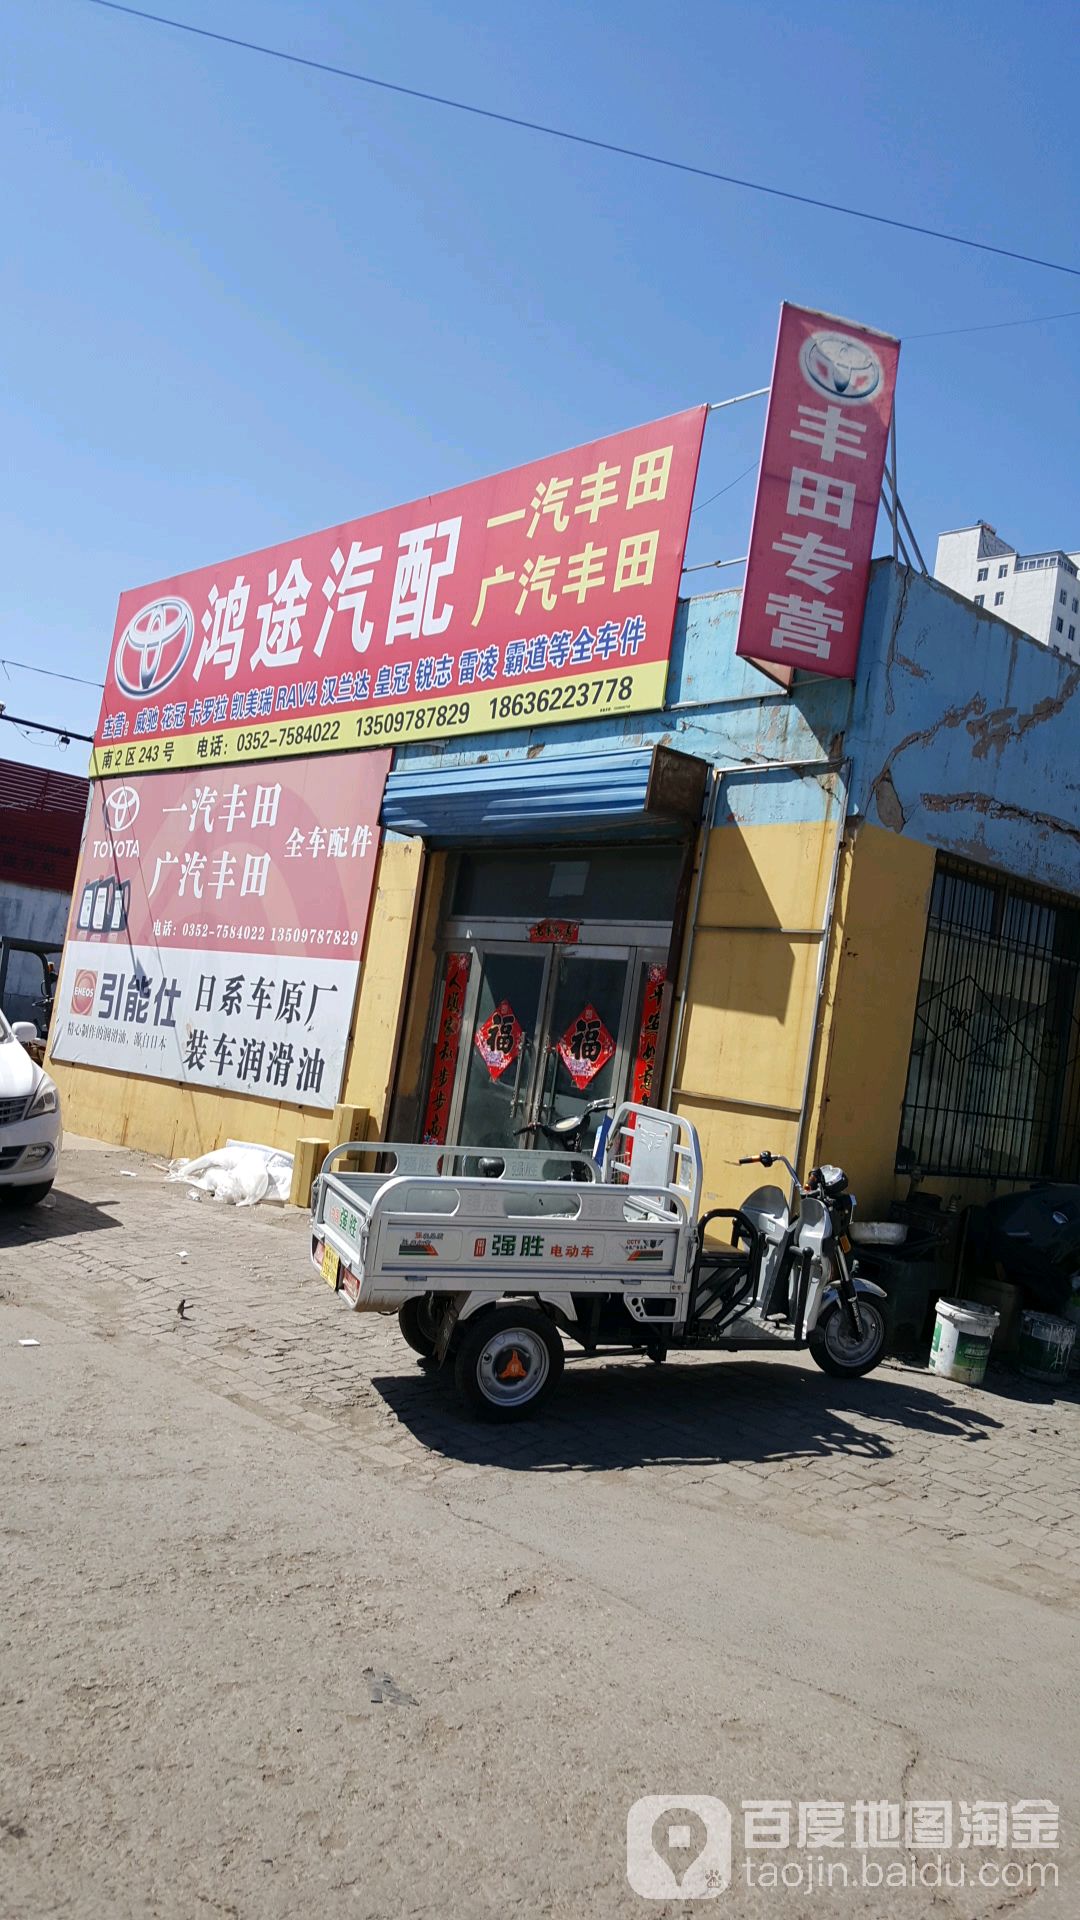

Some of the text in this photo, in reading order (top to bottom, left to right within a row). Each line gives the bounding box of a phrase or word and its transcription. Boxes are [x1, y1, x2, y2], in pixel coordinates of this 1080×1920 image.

[486, 445, 674, 539] 一汽丰田
[765, 404, 867, 660] 丰田专营
[192, 515, 463, 682] 鸿途汽配
[471, 529, 660, 628] 广汽丰田
[275, 680, 318, 711] RAV4
[502, 615, 646, 676] 霸道等全车件
[237, 720, 340, 752] 0352-7584022
[356, 702, 470, 737] 13509787829
[489, 675, 633, 720] 18636223778
[162, 783, 282, 832] 一汽丰田
[93, 839, 140, 859] TOYOTA
[284, 825, 373, 858] 全车配件
[148, 851, 271, 900] 广汽丰田
[182, 922, 265, 941] 0352-7584022
[270, 926, 359, 946] 13509787829
[74, 986, 94, 998] ENEOS
[98, 973, 181, 1028] 引能仕
[194, 974, 338, 1028] 日系车原厂
[486, 1011, 515, 1055] 福
[571, 1019, 602, 1063] 福
[183, 1029, 325, 1094] 装车润滑油
[491, 1234, 594, 1258] 强胜 电动车
